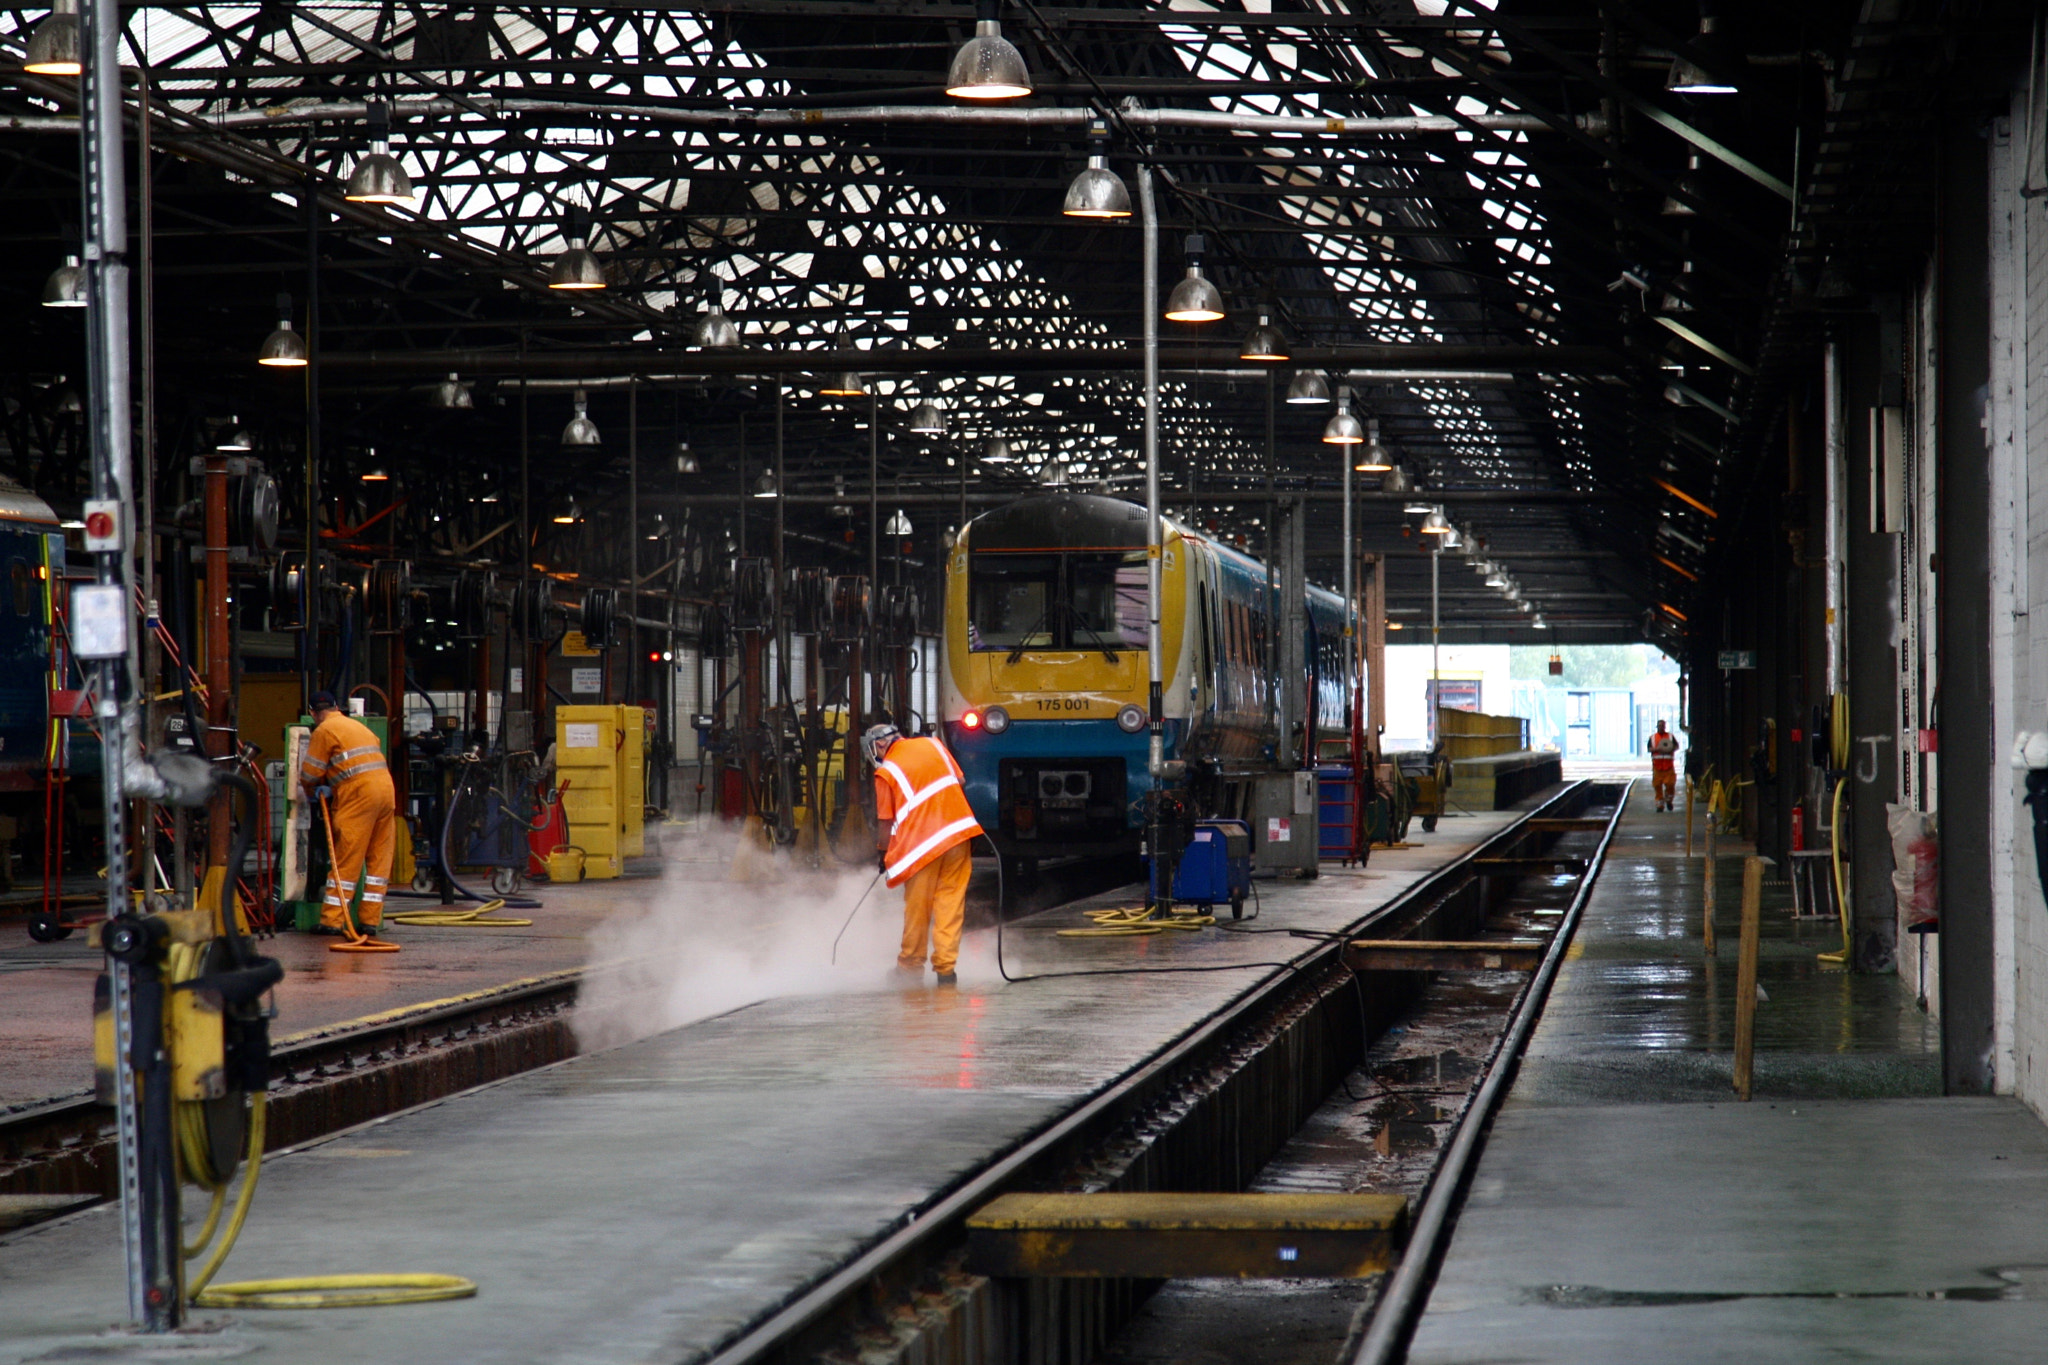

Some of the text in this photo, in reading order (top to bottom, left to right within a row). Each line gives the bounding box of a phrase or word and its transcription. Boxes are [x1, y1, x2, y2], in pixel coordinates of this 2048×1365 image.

[1036, 699, 1089, 711] 175 001
[1856, 735, 1892, 783] J
